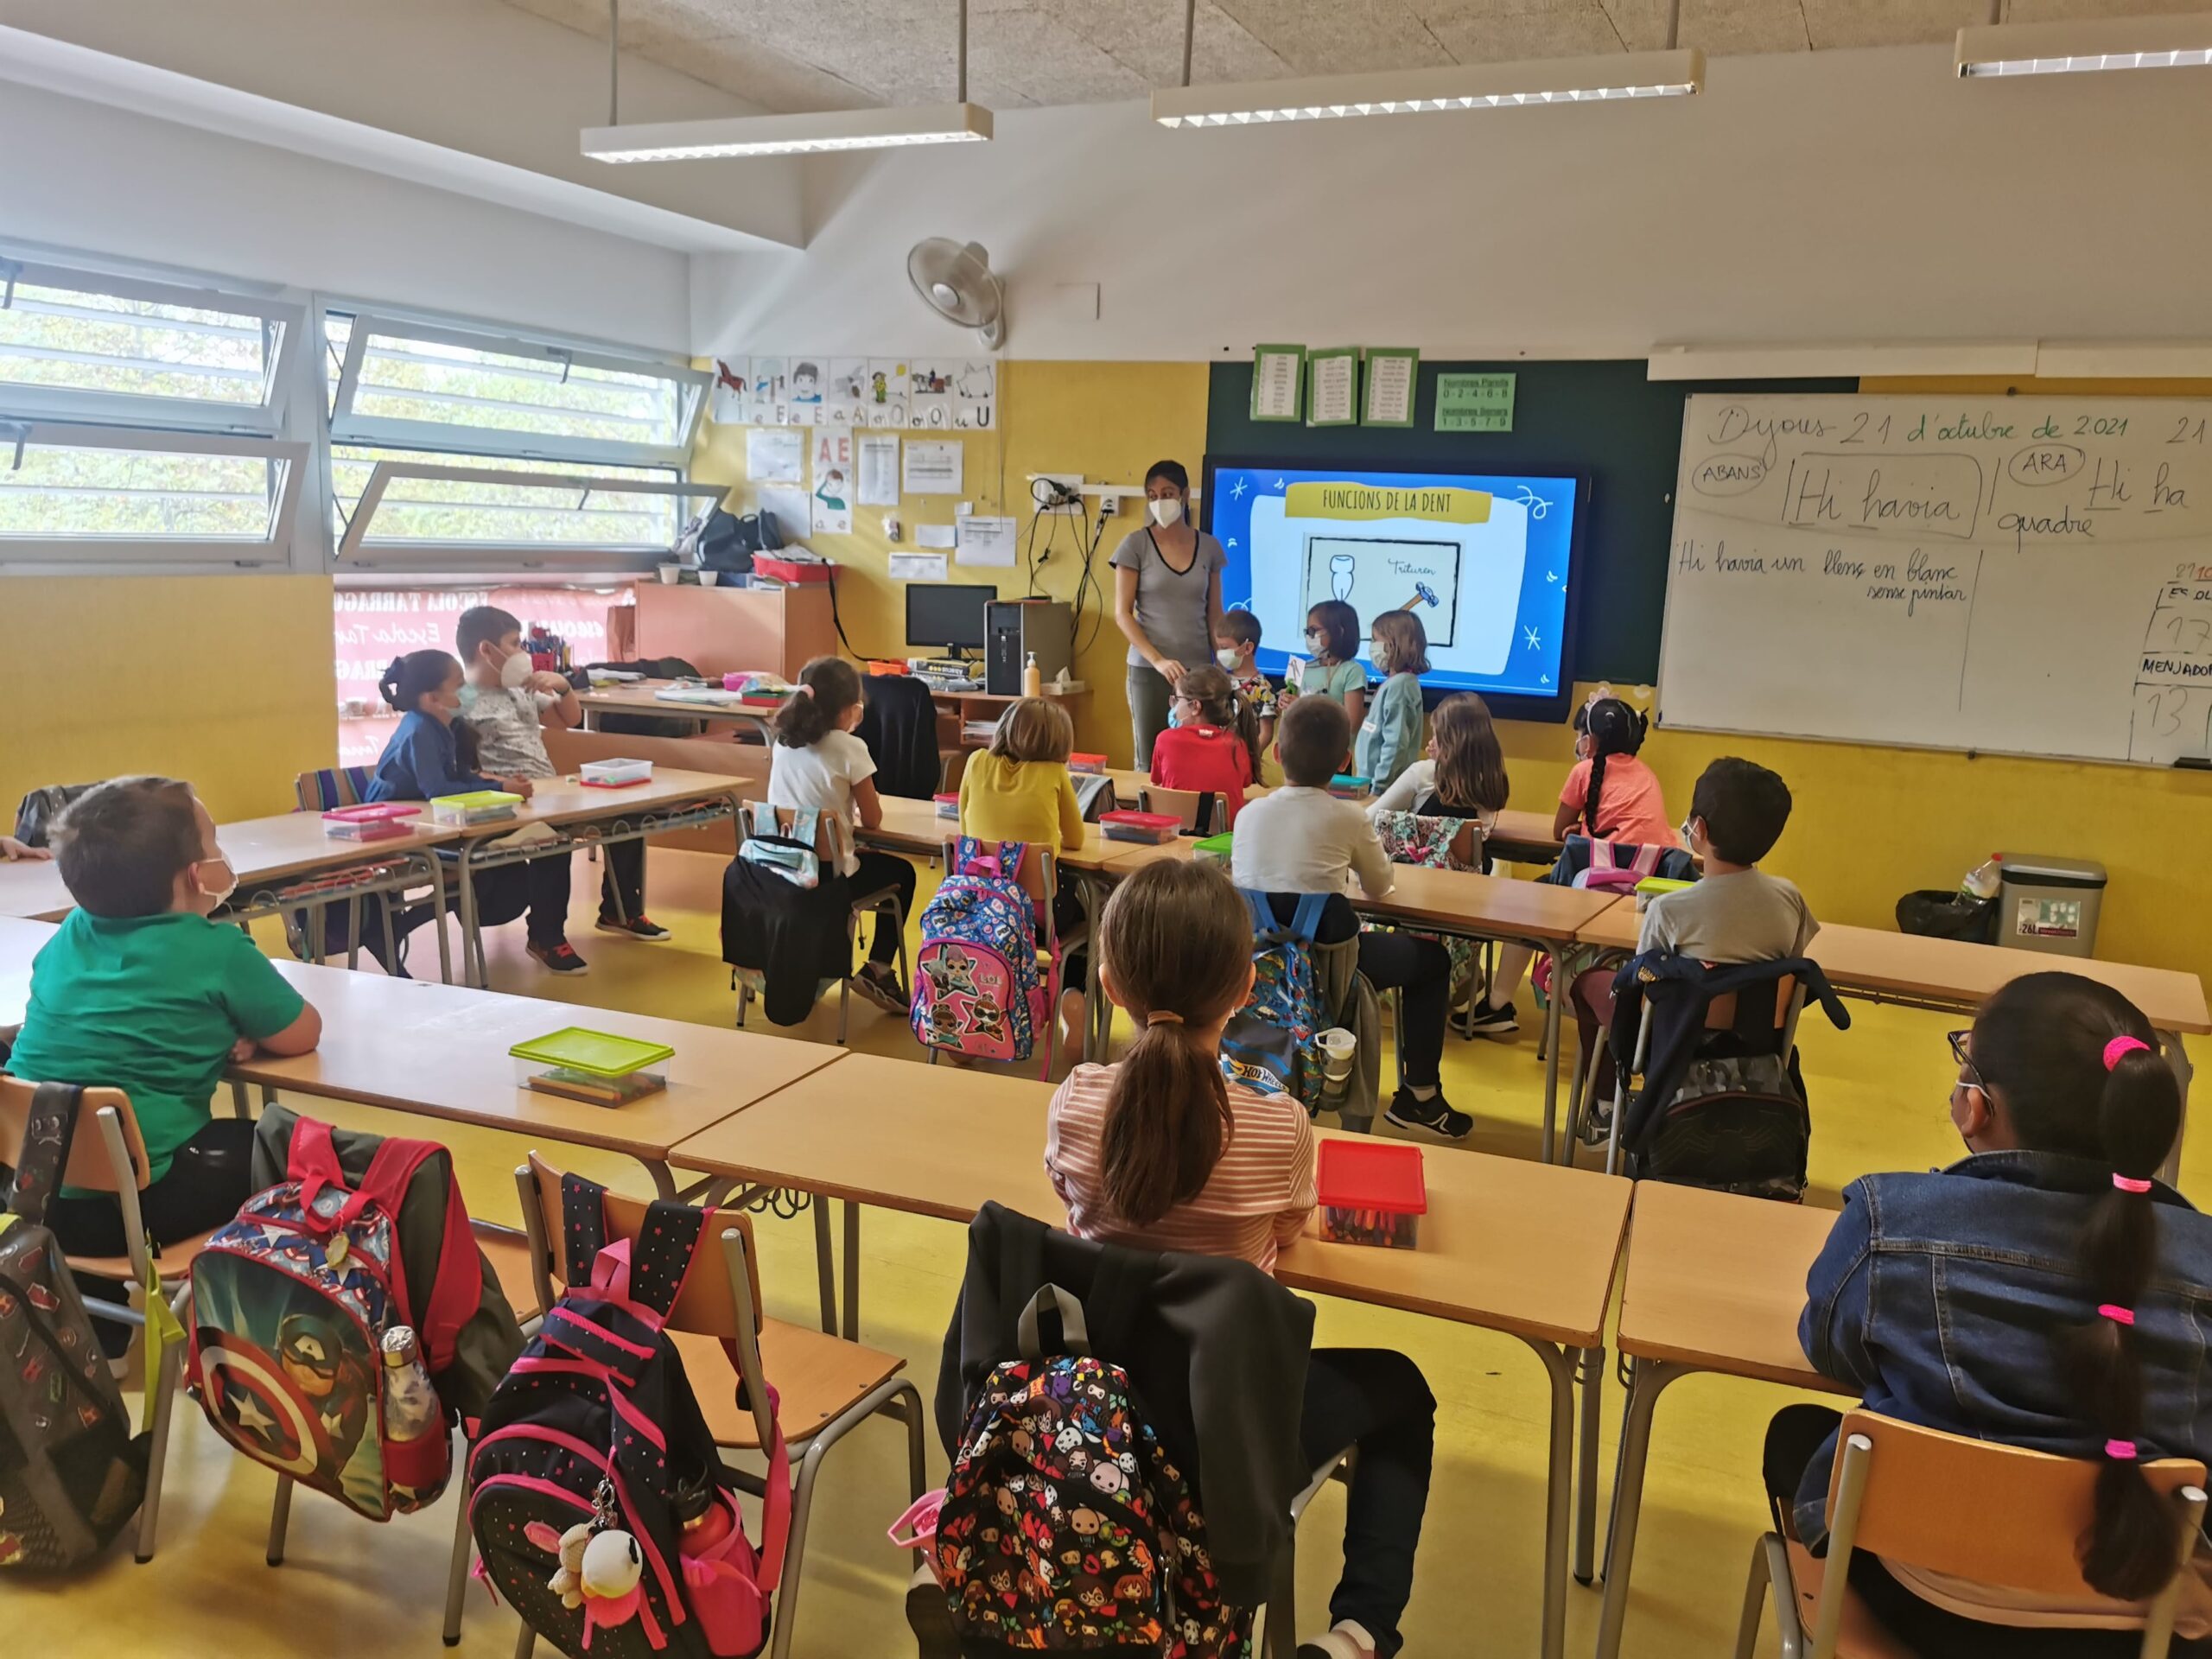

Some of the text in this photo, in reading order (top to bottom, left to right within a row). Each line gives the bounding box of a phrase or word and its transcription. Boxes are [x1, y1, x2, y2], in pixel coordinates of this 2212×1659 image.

[1458, 388, 1464, 398] 2
[1471, 388, 1478, 398] 4
[976, 405, 990, 427] U
[1840, 412, 1891, 444] 21
[2031, 416, 2063, 439] de
[819, 437, 850, 464] A E
[2022, 452, 2067, 475] ARA
[1796, 467, 1961, 522] Hi havia
[2088, 457, 2189, 508] Hi ha
[1323, 489, 1452, 512] FUNCIONS DE LA DENT
[1388, 557, 1436, 575] Trituren
[1679, 539, 1706, 575] Hi
[1715, 540, 1767, 575] havia
[1771, 556, 1806, 574] un
[1873, 563, 1898, 581] en
[1907, 548, 1958, 582] blanc
[2167, 616, 2211, 652] 17
[2148, 687, 2188, 737] 13
[1243, 1065, 1262, 1078] HOT
